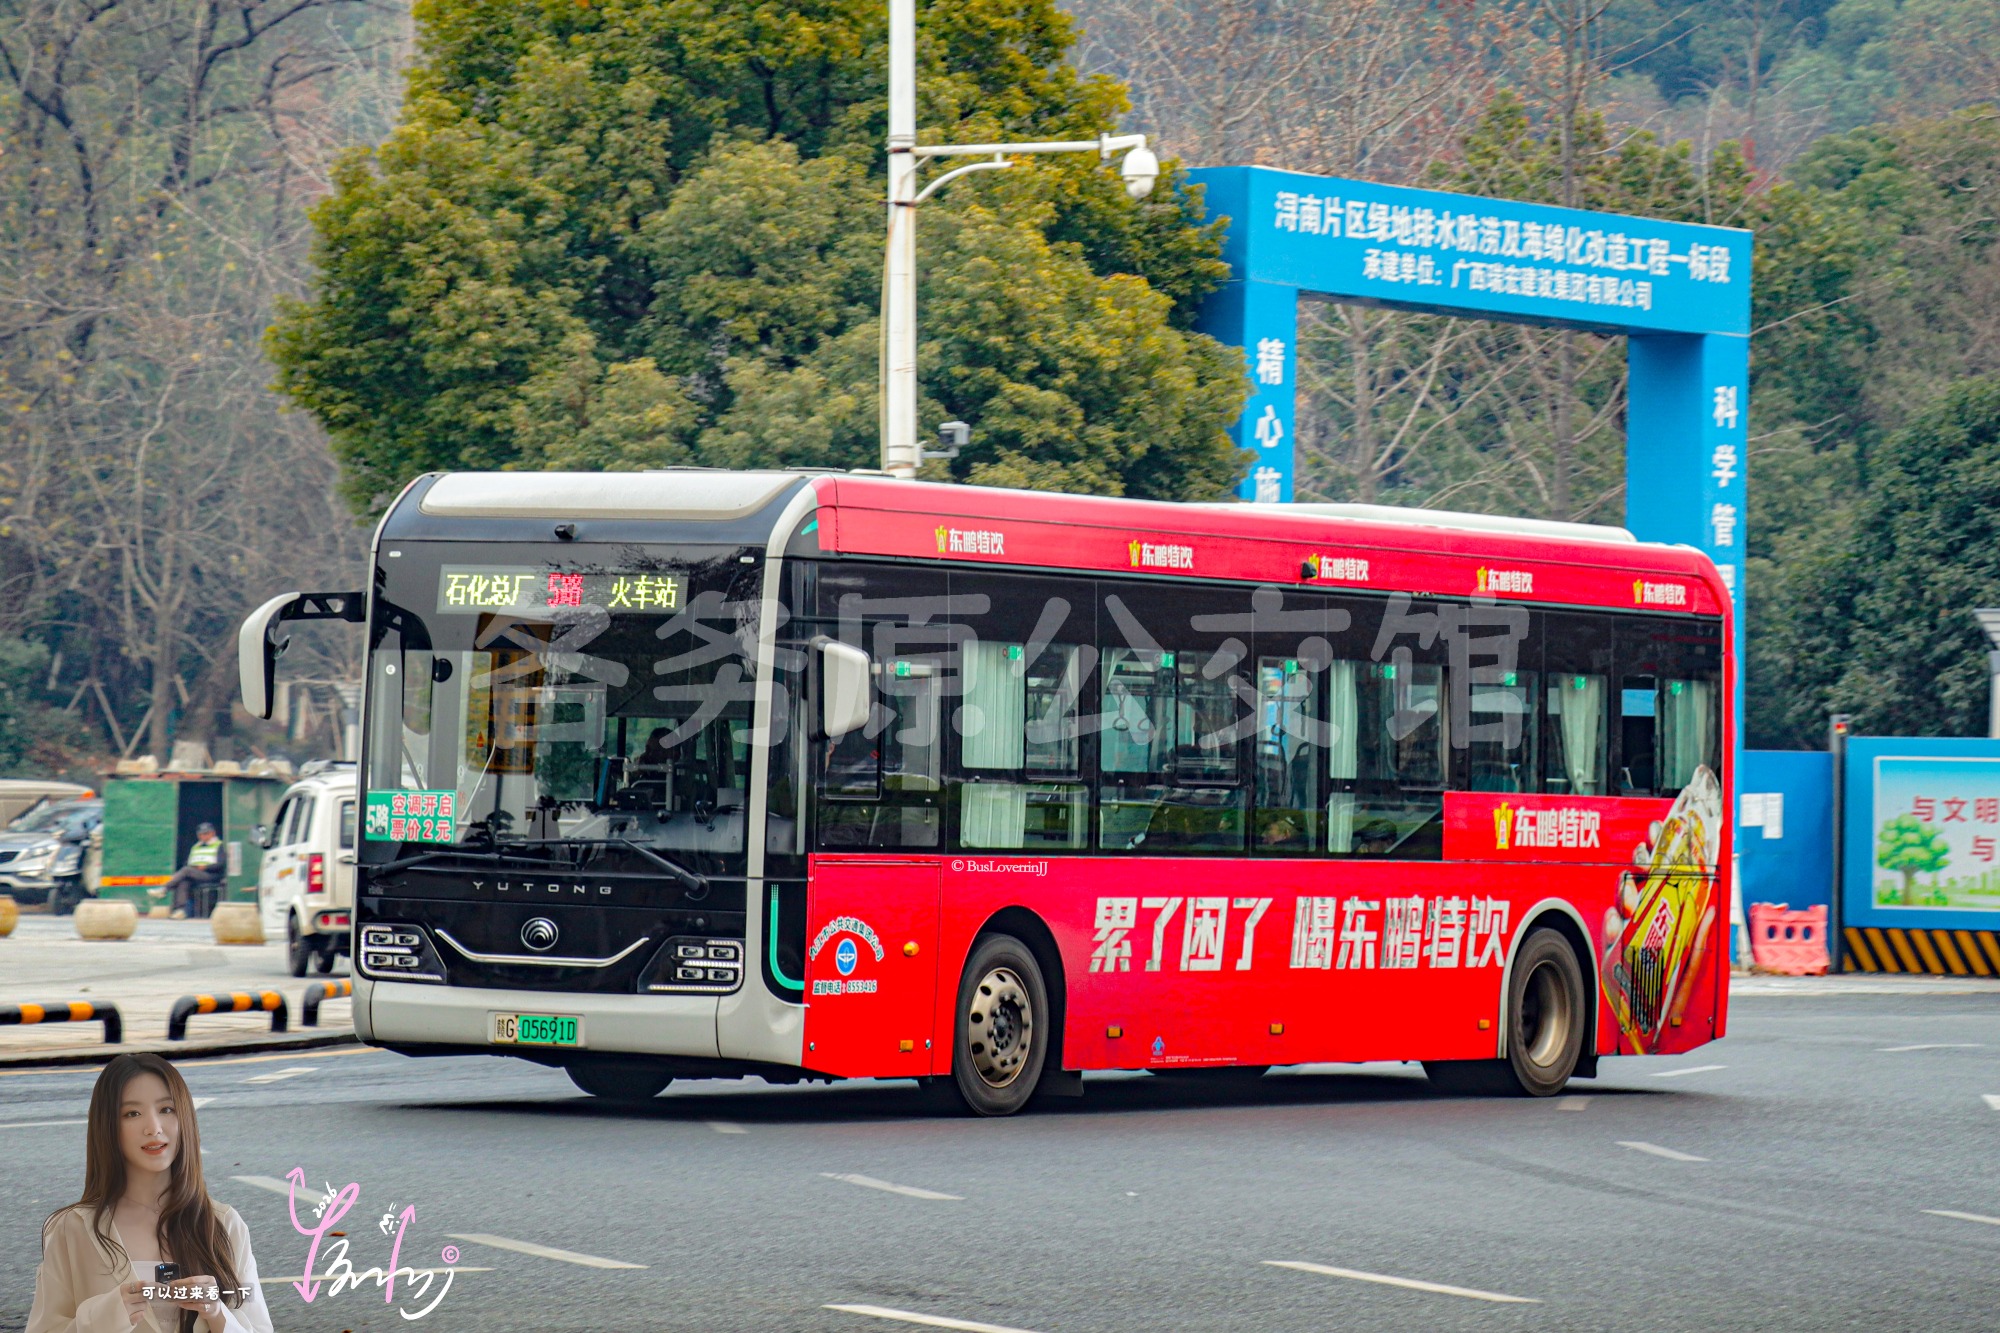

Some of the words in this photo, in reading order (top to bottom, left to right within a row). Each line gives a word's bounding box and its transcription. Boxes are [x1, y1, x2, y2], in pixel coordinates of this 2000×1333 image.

[949, 527, 1004, 555] 东鹏特饮
[1141, 543, 1193, 569] 东鹏特饮
[1320, 556, 1369, 581] 东鹏特饮
[446, 574, 535, 606] 石化总厂
[547, 572, 583, 608] 5路
[608, 575, 678, 610] 火车站
[1487, 568, 1533, 594] 东鹏特饮
[1642, 580, 1687, 606] 东鹏特饮
[391, 794, 452, 817] 空调开启
[1910, 795, 2000, 823] 与文明
[366, 804, 389, 835] 5路
[390, 818, 451, 841] 票价2元
[1515, 806, 1600, 848] 东鹏特饮
[473, 881, 612, 895] YUTONG
[1089, 896, 1273, 973] 累了困了
[1289, 894, 1510, 970] 喝东鹏特饮
